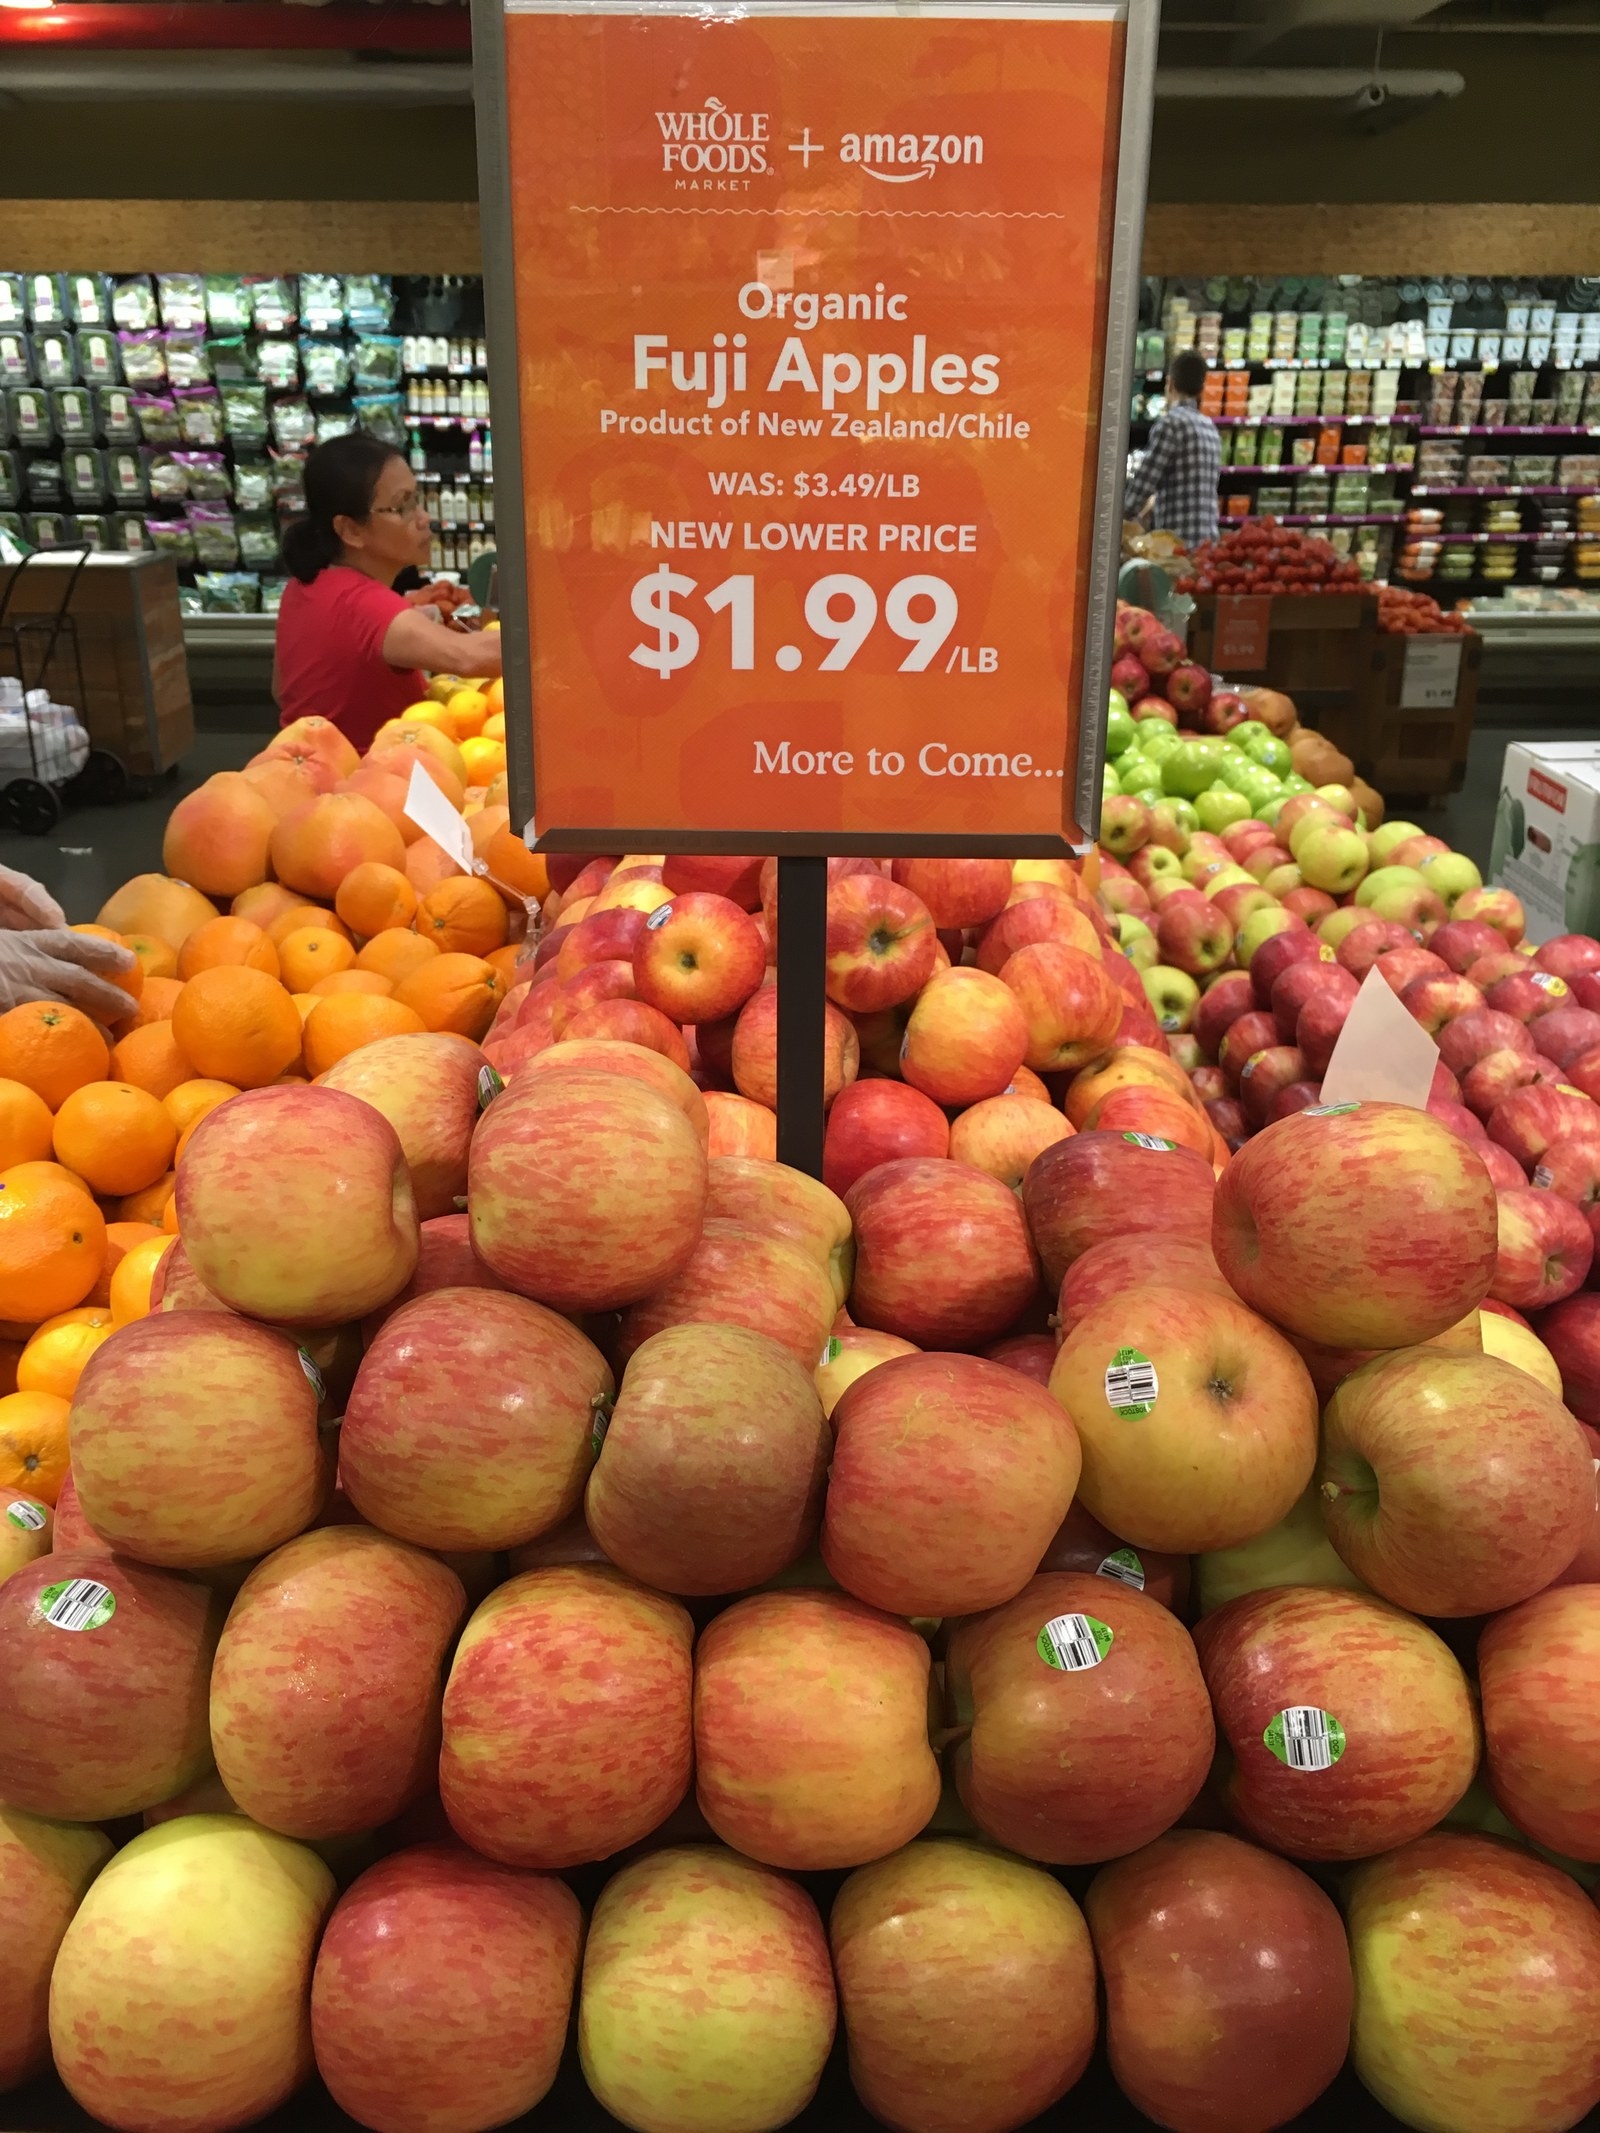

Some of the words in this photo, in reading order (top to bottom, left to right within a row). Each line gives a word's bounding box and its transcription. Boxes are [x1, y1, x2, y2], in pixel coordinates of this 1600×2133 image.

[655, 97, 770, 141] WHOLE
[662, 143, 767, 173] FOODS
[840, 133, 984, 166] amazon
[675, 179, 751, 191] MARKET
[738, 282, 908, 330] Organic
[633, 333, 747, 408] Fuji
[766, 334, 1001, 411] Apples
[600, 411, 713, 437] Product
[720, 411, 750, 436] of
[758, 413, 826, 437] New
[830, 413, 1031, 440] Zealand/Chile
[708, 472, 784, 496] WAS:
[793, 472, 920, 499] $3.49/LB
[650, 521, 733, 550] NEW
[743, 522, 867, 552] LOWER
[878, 524, 977, 553] PRICE
[753, 741, 854, 775] More
[866, 747, 905, 776] to
[918, 743, 1064, 778] Come...
[1040, 1633, 1056, 1665] BOSTOCK
